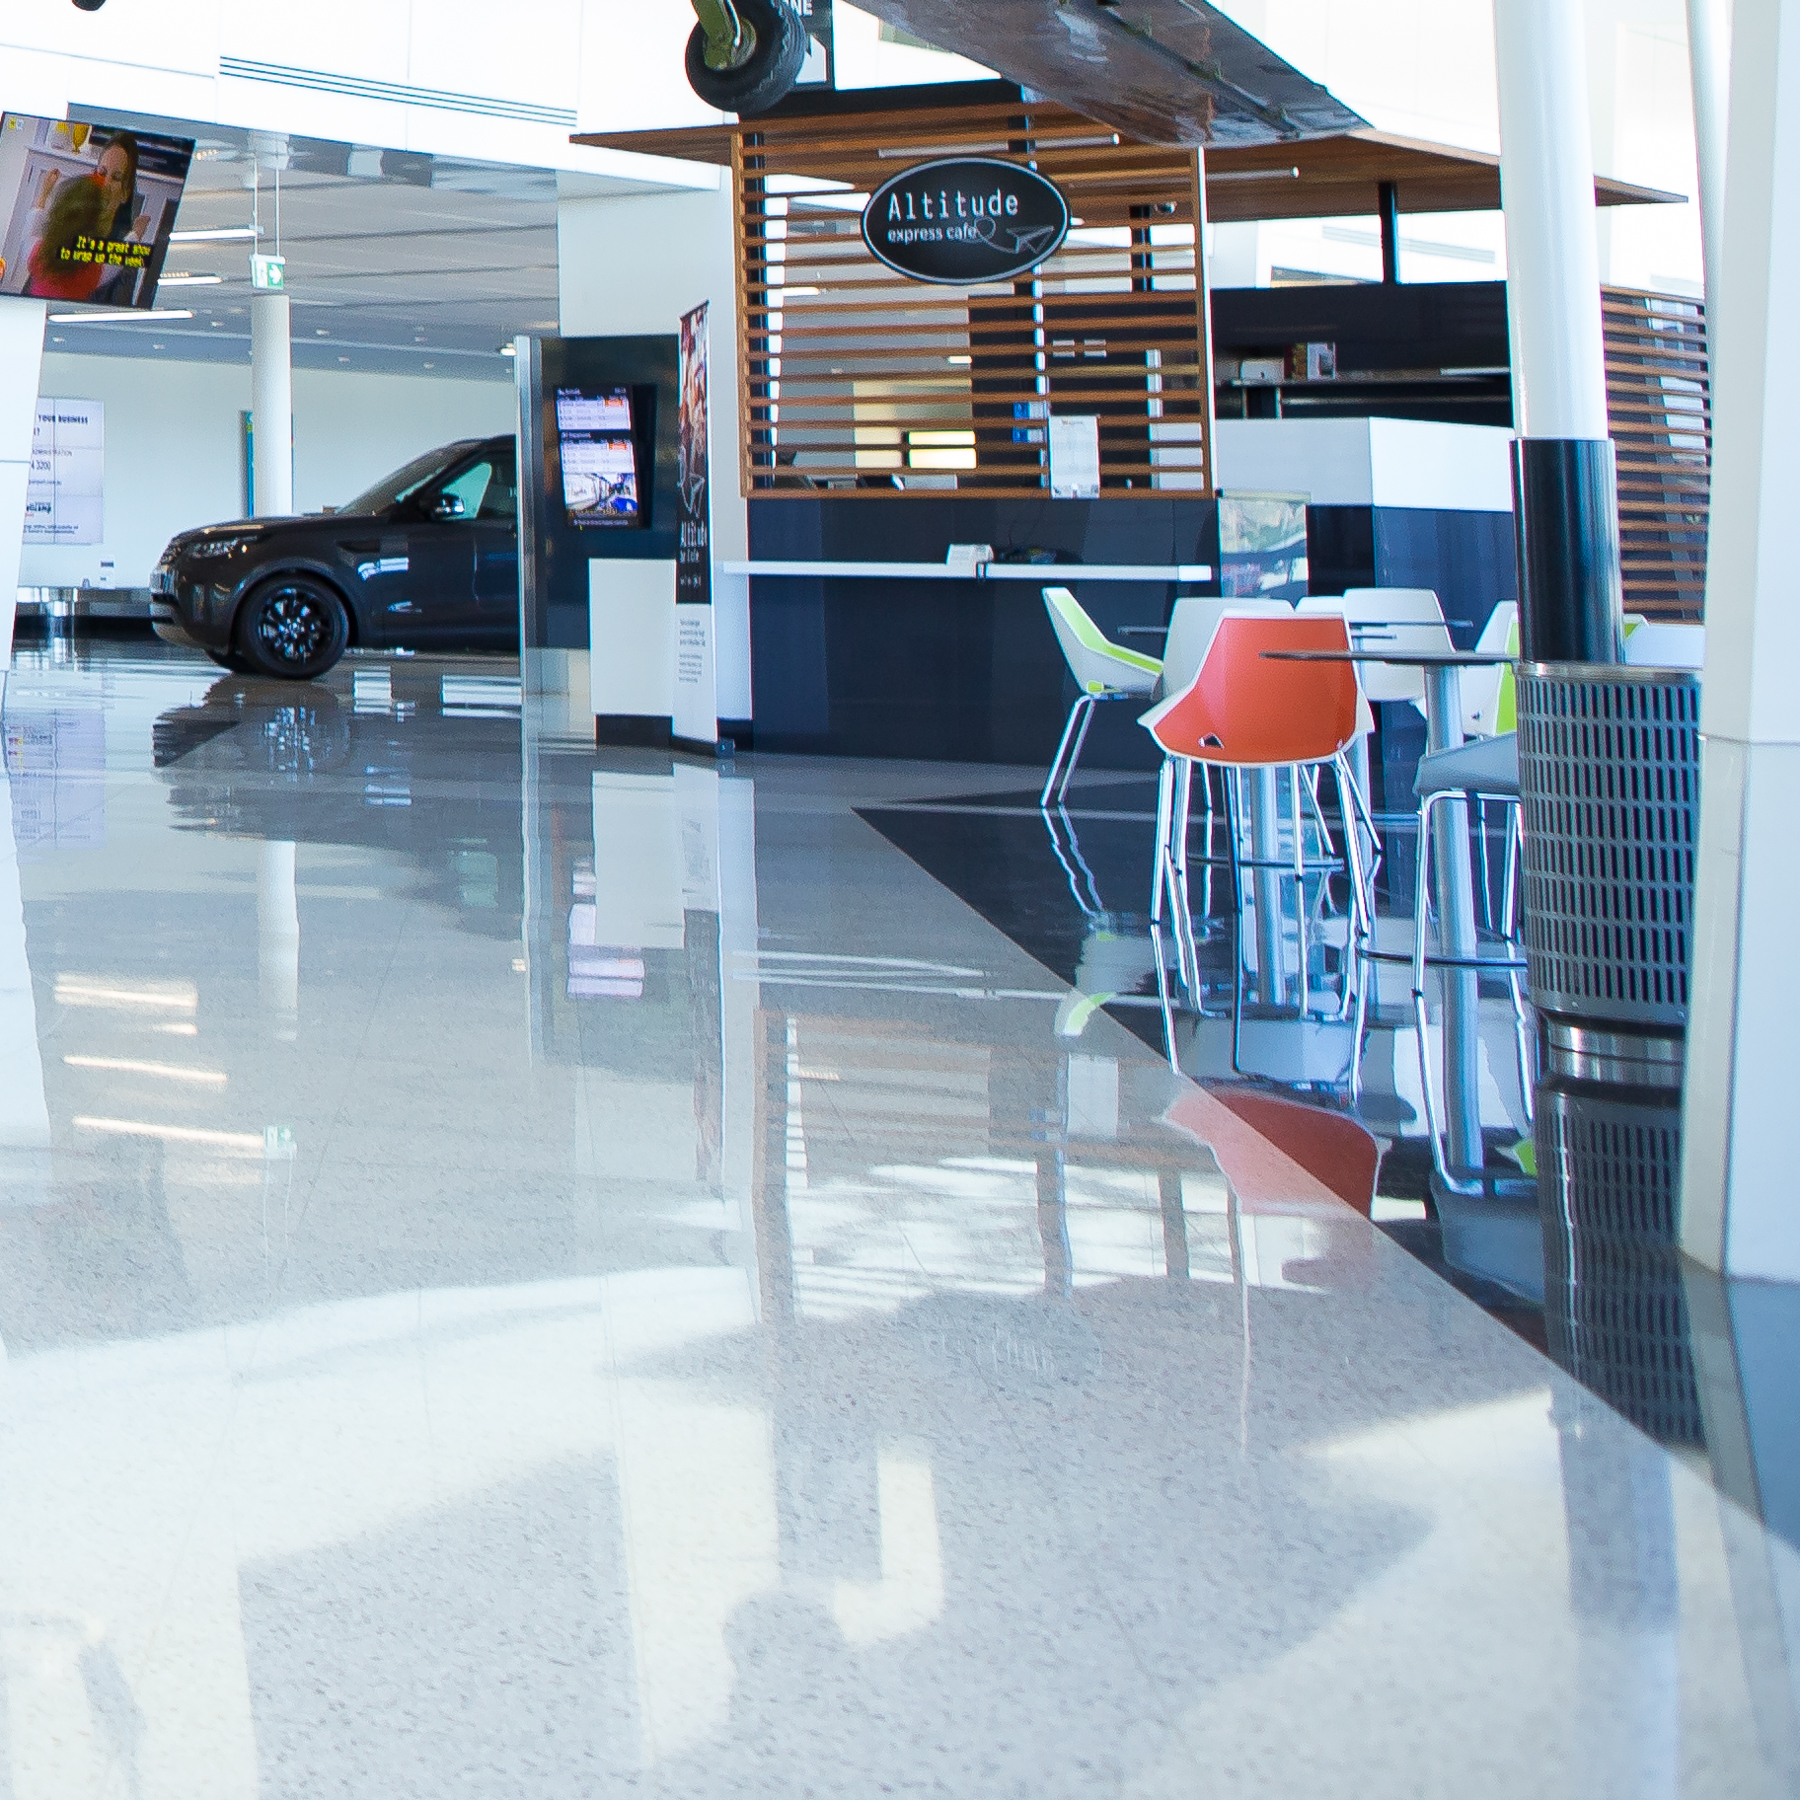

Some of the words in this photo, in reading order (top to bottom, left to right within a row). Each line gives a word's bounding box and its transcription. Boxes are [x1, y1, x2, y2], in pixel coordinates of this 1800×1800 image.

[887, 187, 1019, 221] Altitude
[887, 226, 944, 245] express
[945, 222, 979, 242] cafe
